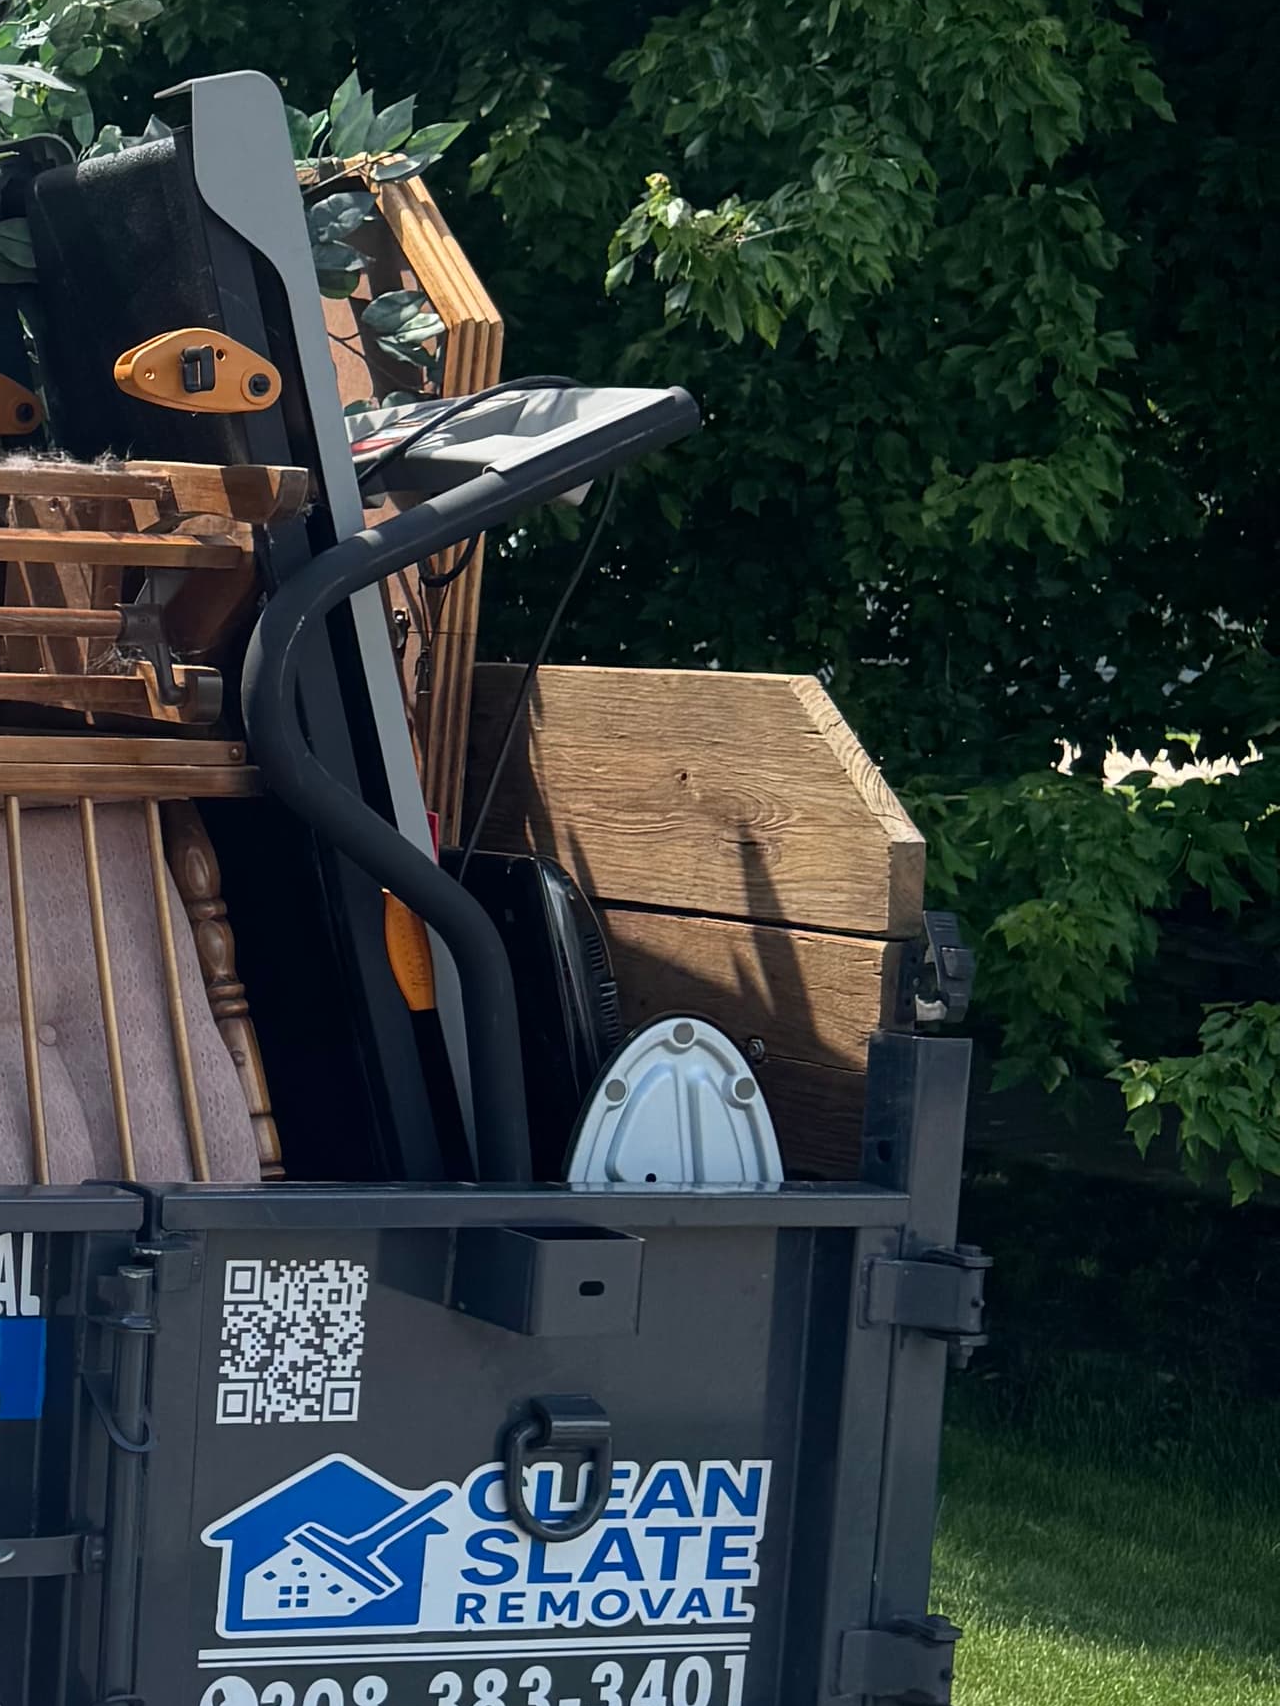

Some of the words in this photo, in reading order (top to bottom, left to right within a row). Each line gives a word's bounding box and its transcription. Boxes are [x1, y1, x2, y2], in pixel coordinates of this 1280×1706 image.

[468, 1467, 760, 1523] CLEAN
[460, 1527, 752, 1586] SLATE
[454, 1587, 748, 1624] REMOVAL
